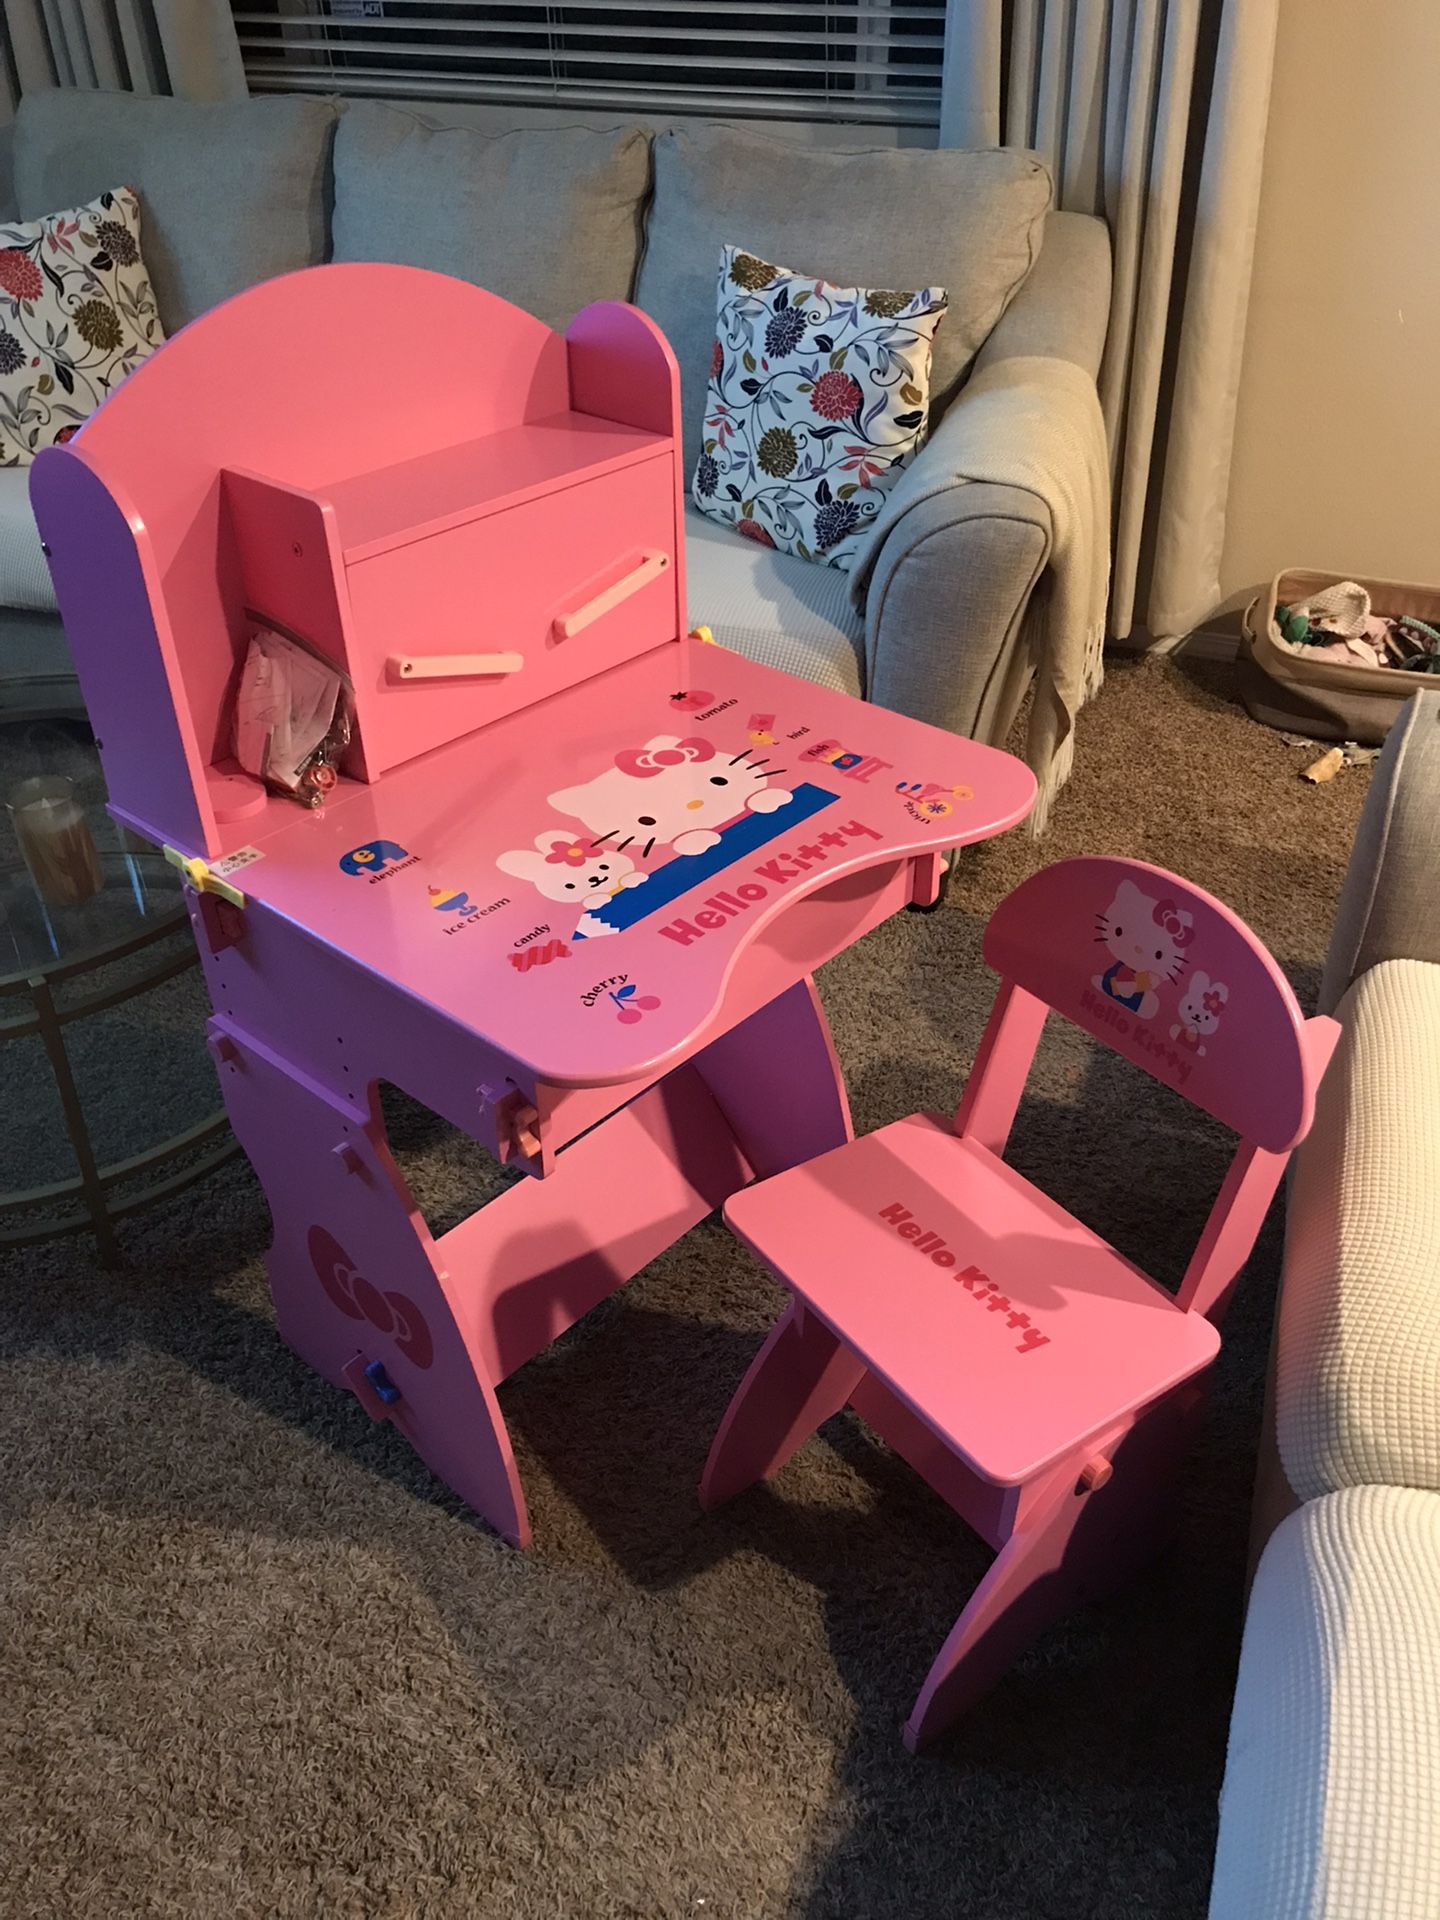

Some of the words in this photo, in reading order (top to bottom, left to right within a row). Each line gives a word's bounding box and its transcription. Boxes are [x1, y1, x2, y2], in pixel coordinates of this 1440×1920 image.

[364, 3, 380, 15] ADT
[695, 699, 738, 721] tomato
[787, 727, 811, 741] bird
[369, 856, 422, 884] elephant
[658, 881, 768, 946] Hello
[753, 820, 883, 885] Kitty
[442, 921, 465, 936] ice
[467, 897, 511, 924] cream
[513, 923, 551, 948] candy
[580, 973, 628, 1007] cherry
[1080, 989, 1129, 1034] Hello
[1133, 1024, 1193, 1085] Kitty
[878, 1202, 956, 1268] Hello
[953, 1265, 1051, 1354] Kitty
